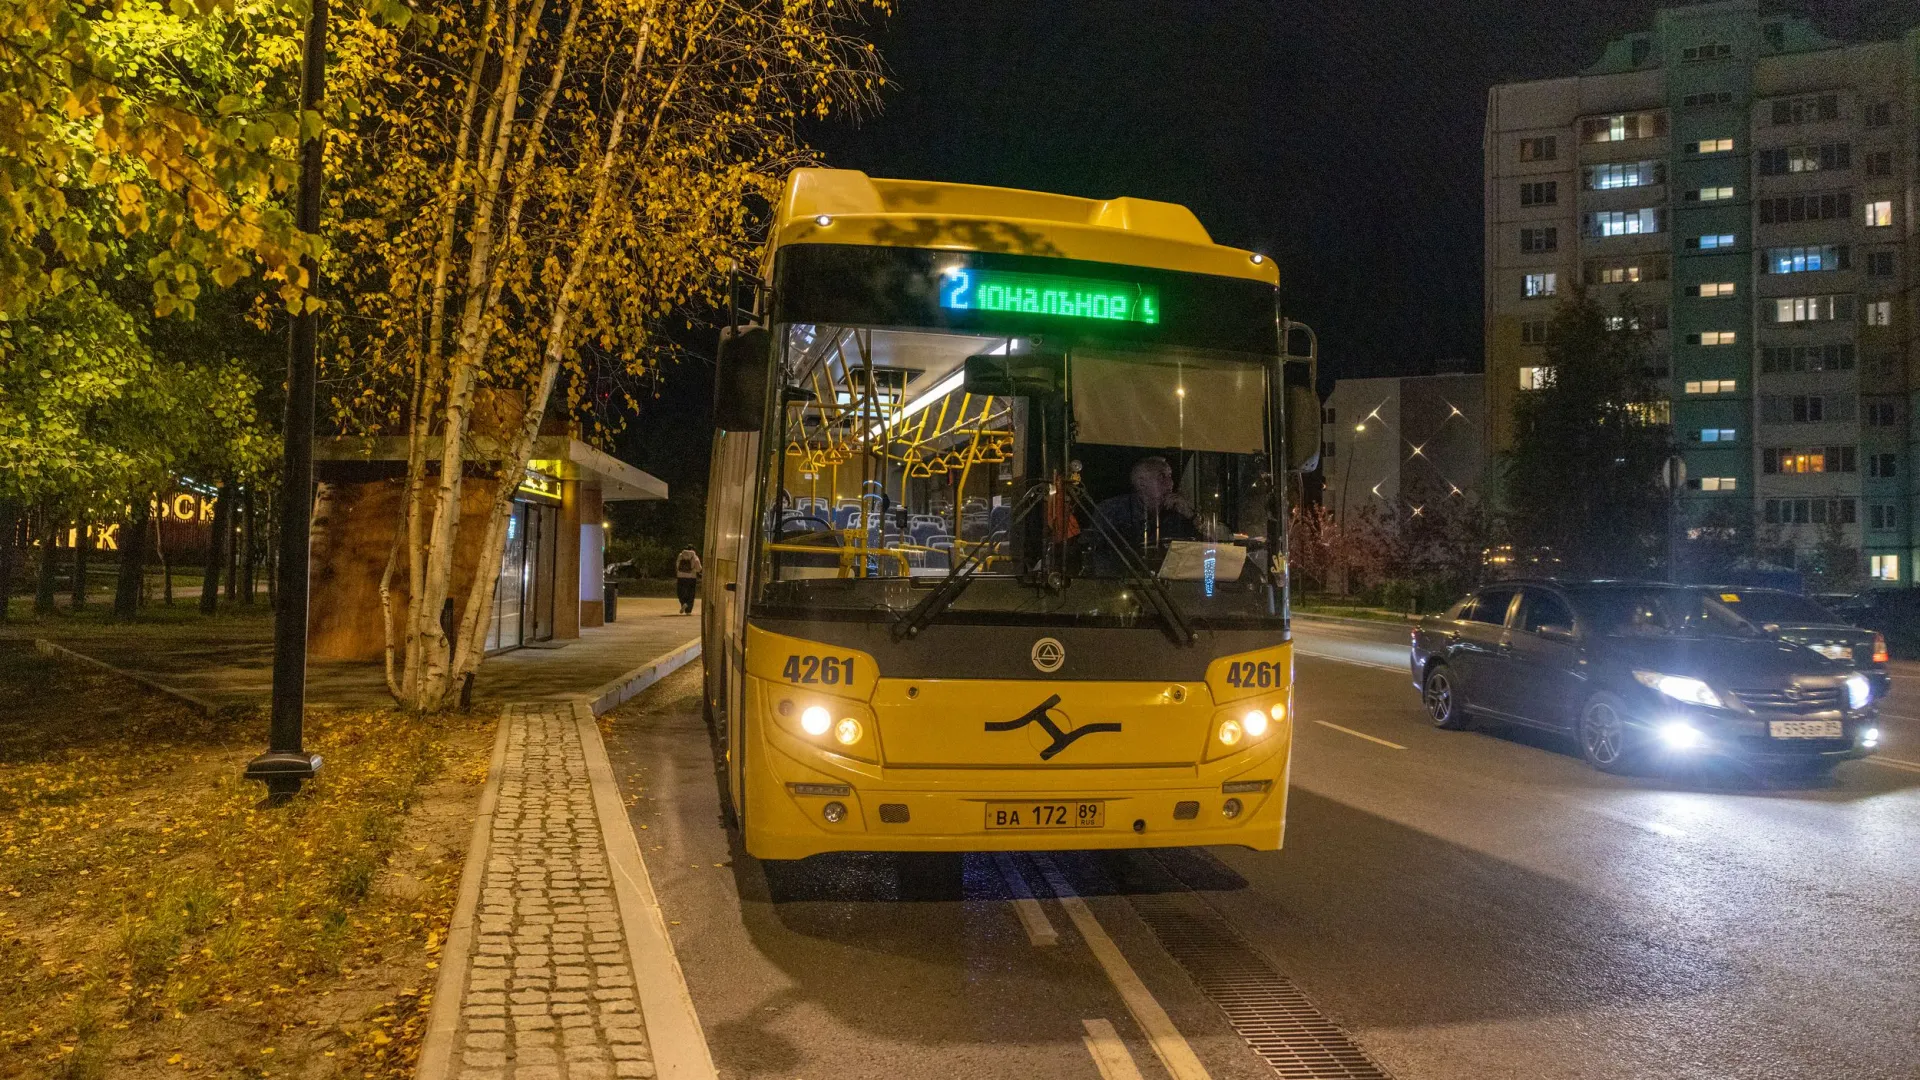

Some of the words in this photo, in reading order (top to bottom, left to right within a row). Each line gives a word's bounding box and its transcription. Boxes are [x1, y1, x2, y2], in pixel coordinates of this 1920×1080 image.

[951, 270, 968, 309] 2
[782, 655, 854, 686] 4261
[1226, 661, 1281, 688] 4261
[1032, 806, 1067, 825] 172
[1078, 804, 1097, 818] 89
